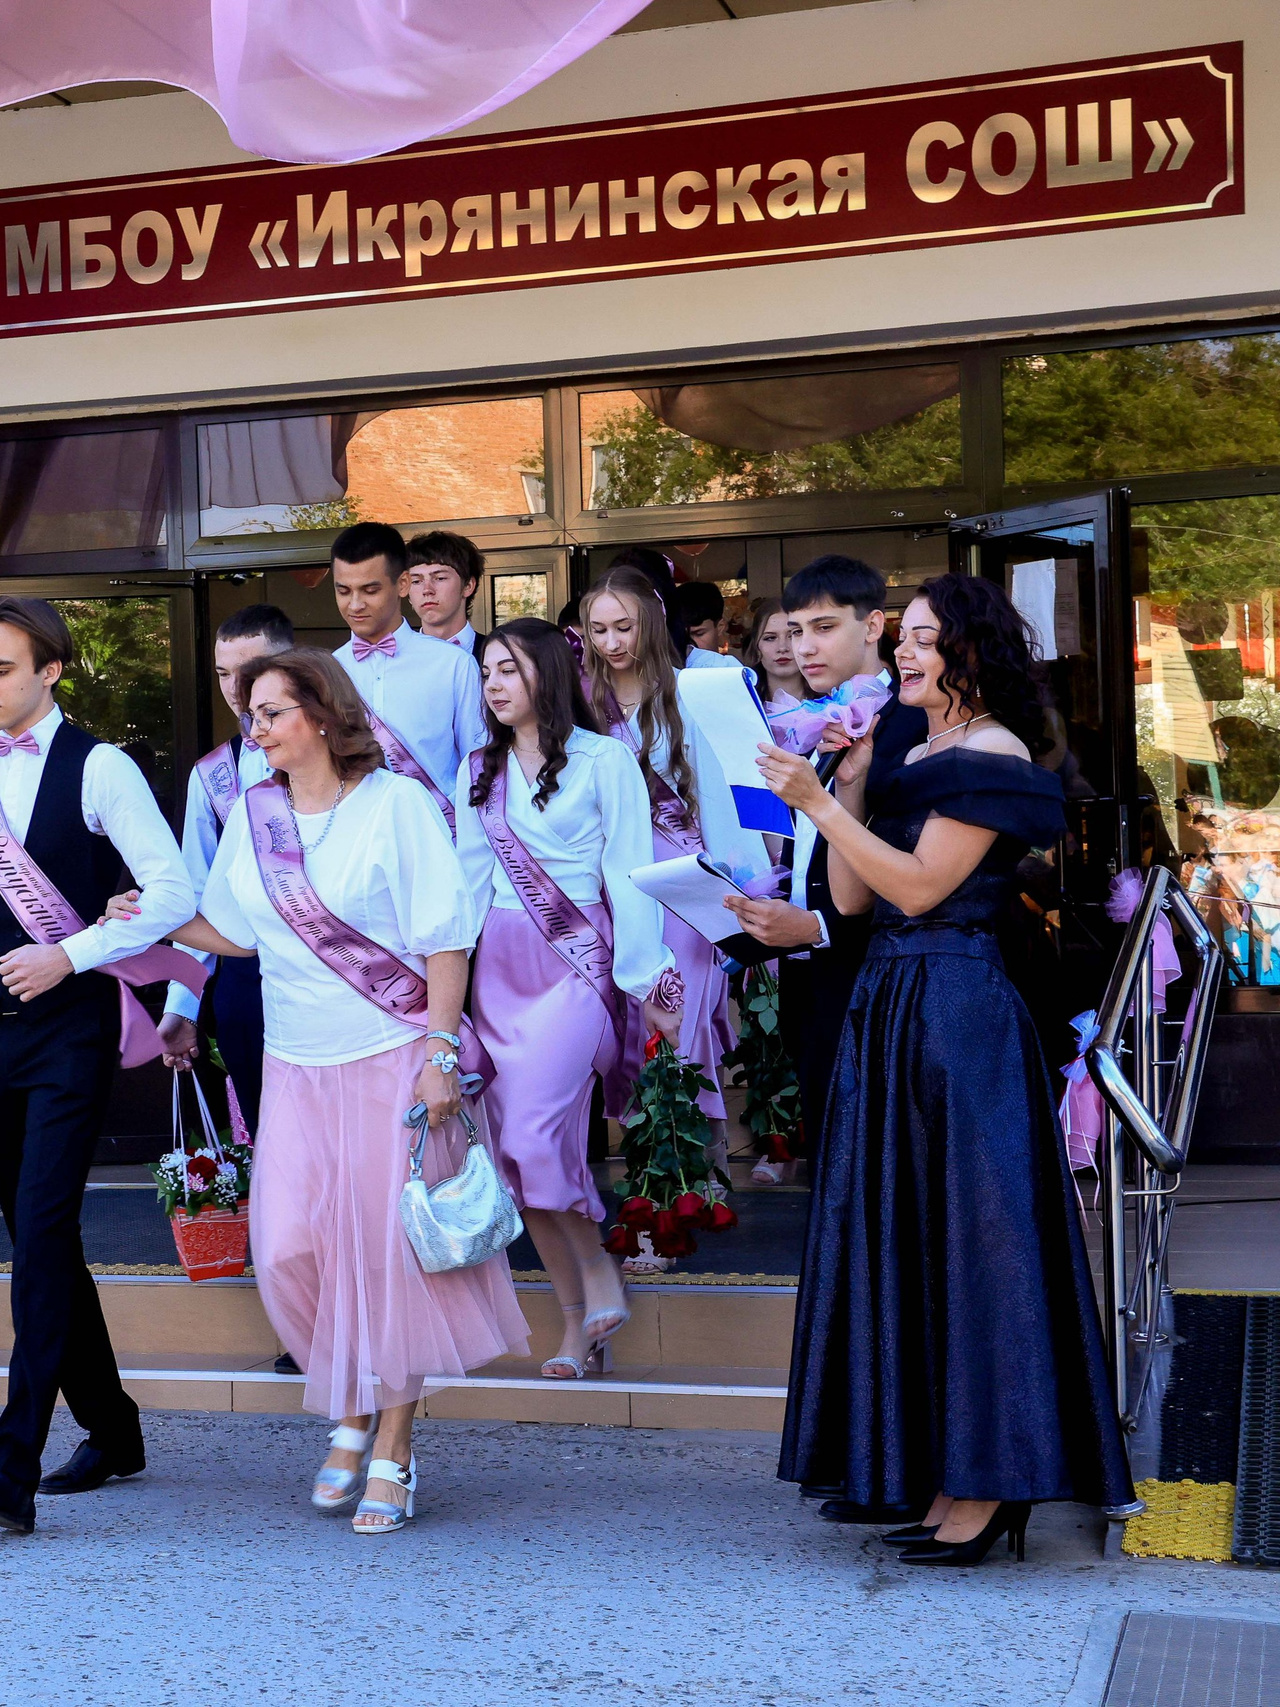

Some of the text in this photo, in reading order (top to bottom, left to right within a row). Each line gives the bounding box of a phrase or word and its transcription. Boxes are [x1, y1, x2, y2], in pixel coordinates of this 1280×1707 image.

[4, 97, 1195, 297] МБОУ «Икрянинская СОШ»
[271, 861, 311, 919] Классный
[492, 816, 579, 944] Выпускница
